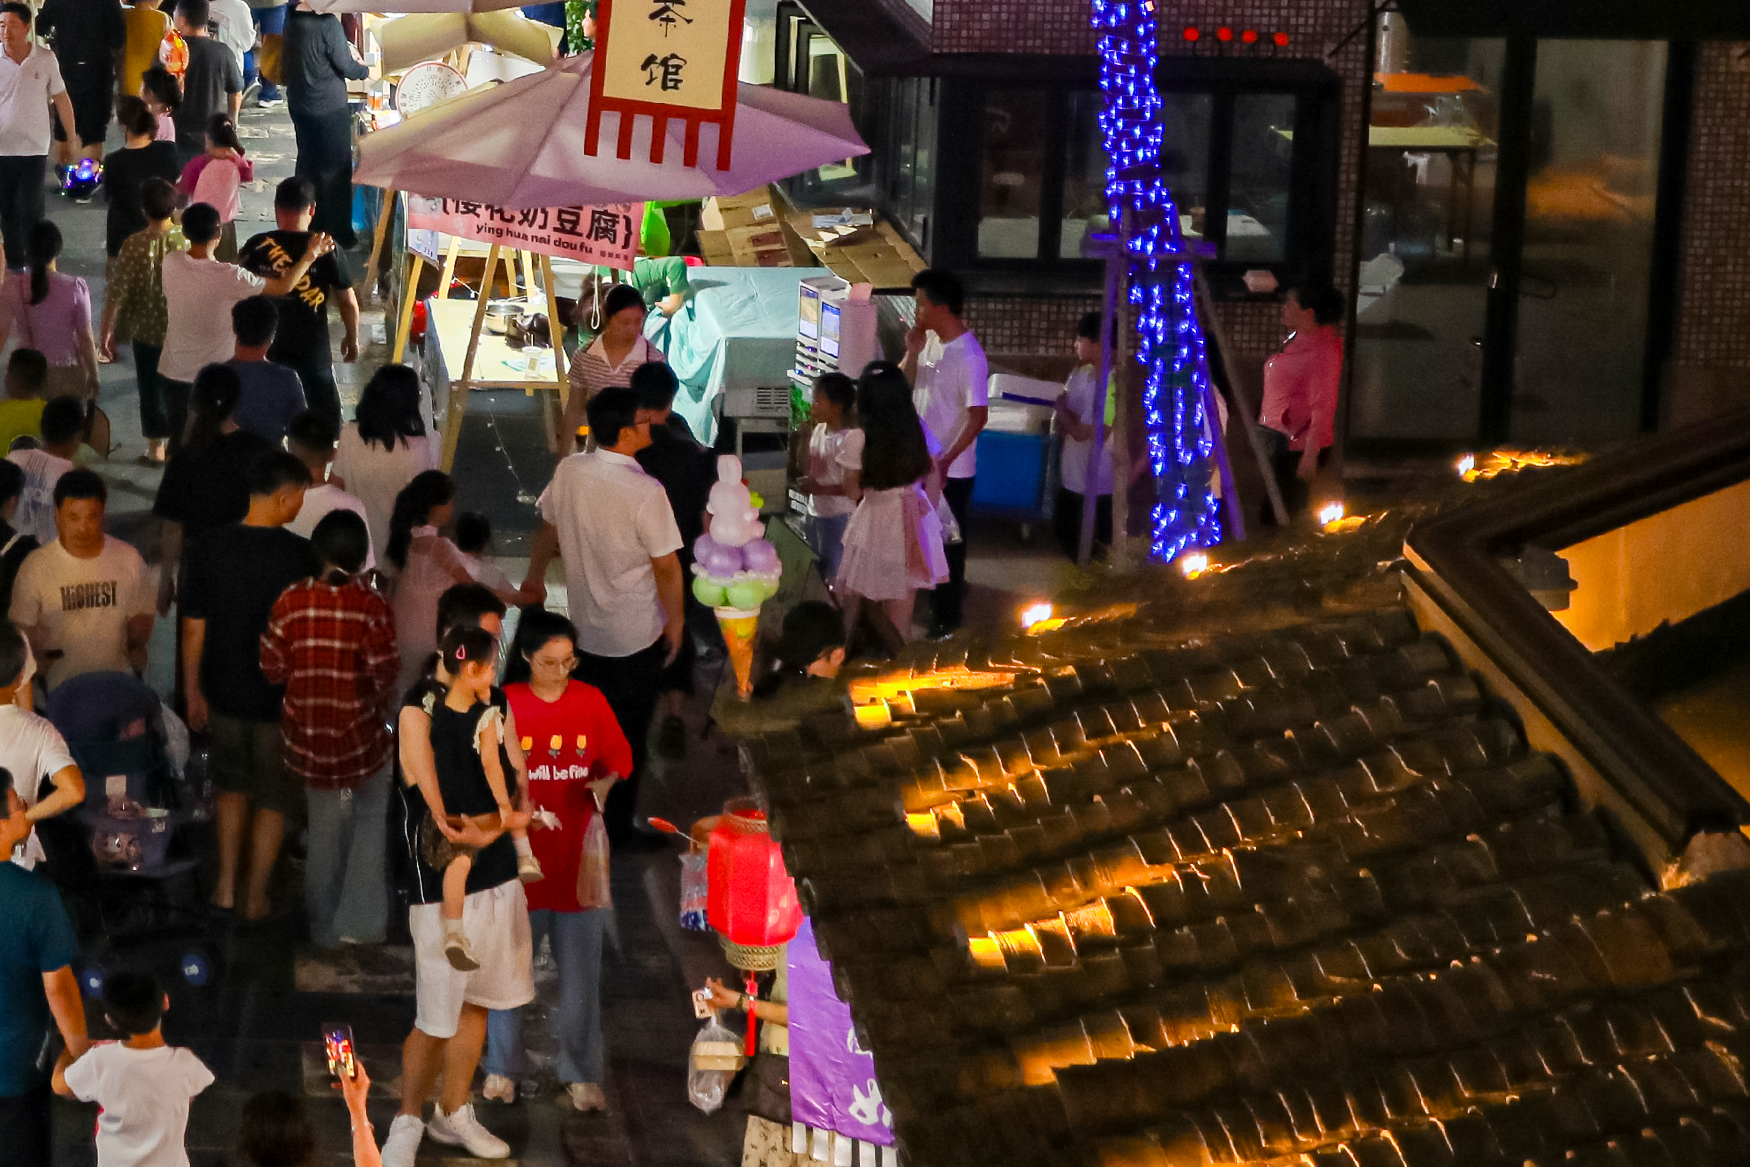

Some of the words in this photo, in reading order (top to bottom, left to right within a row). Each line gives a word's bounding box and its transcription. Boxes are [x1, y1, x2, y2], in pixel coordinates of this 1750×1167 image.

[476, 222, 503, 238] ying
[506, 227, 529, 241] hua
[531, 234, 550, 245] nai
[553, 237, 579, 252] dou
[579, 240, 593, 254] fu
[528, 764, 550, 781] will
[553, 765, 569, 781] be
